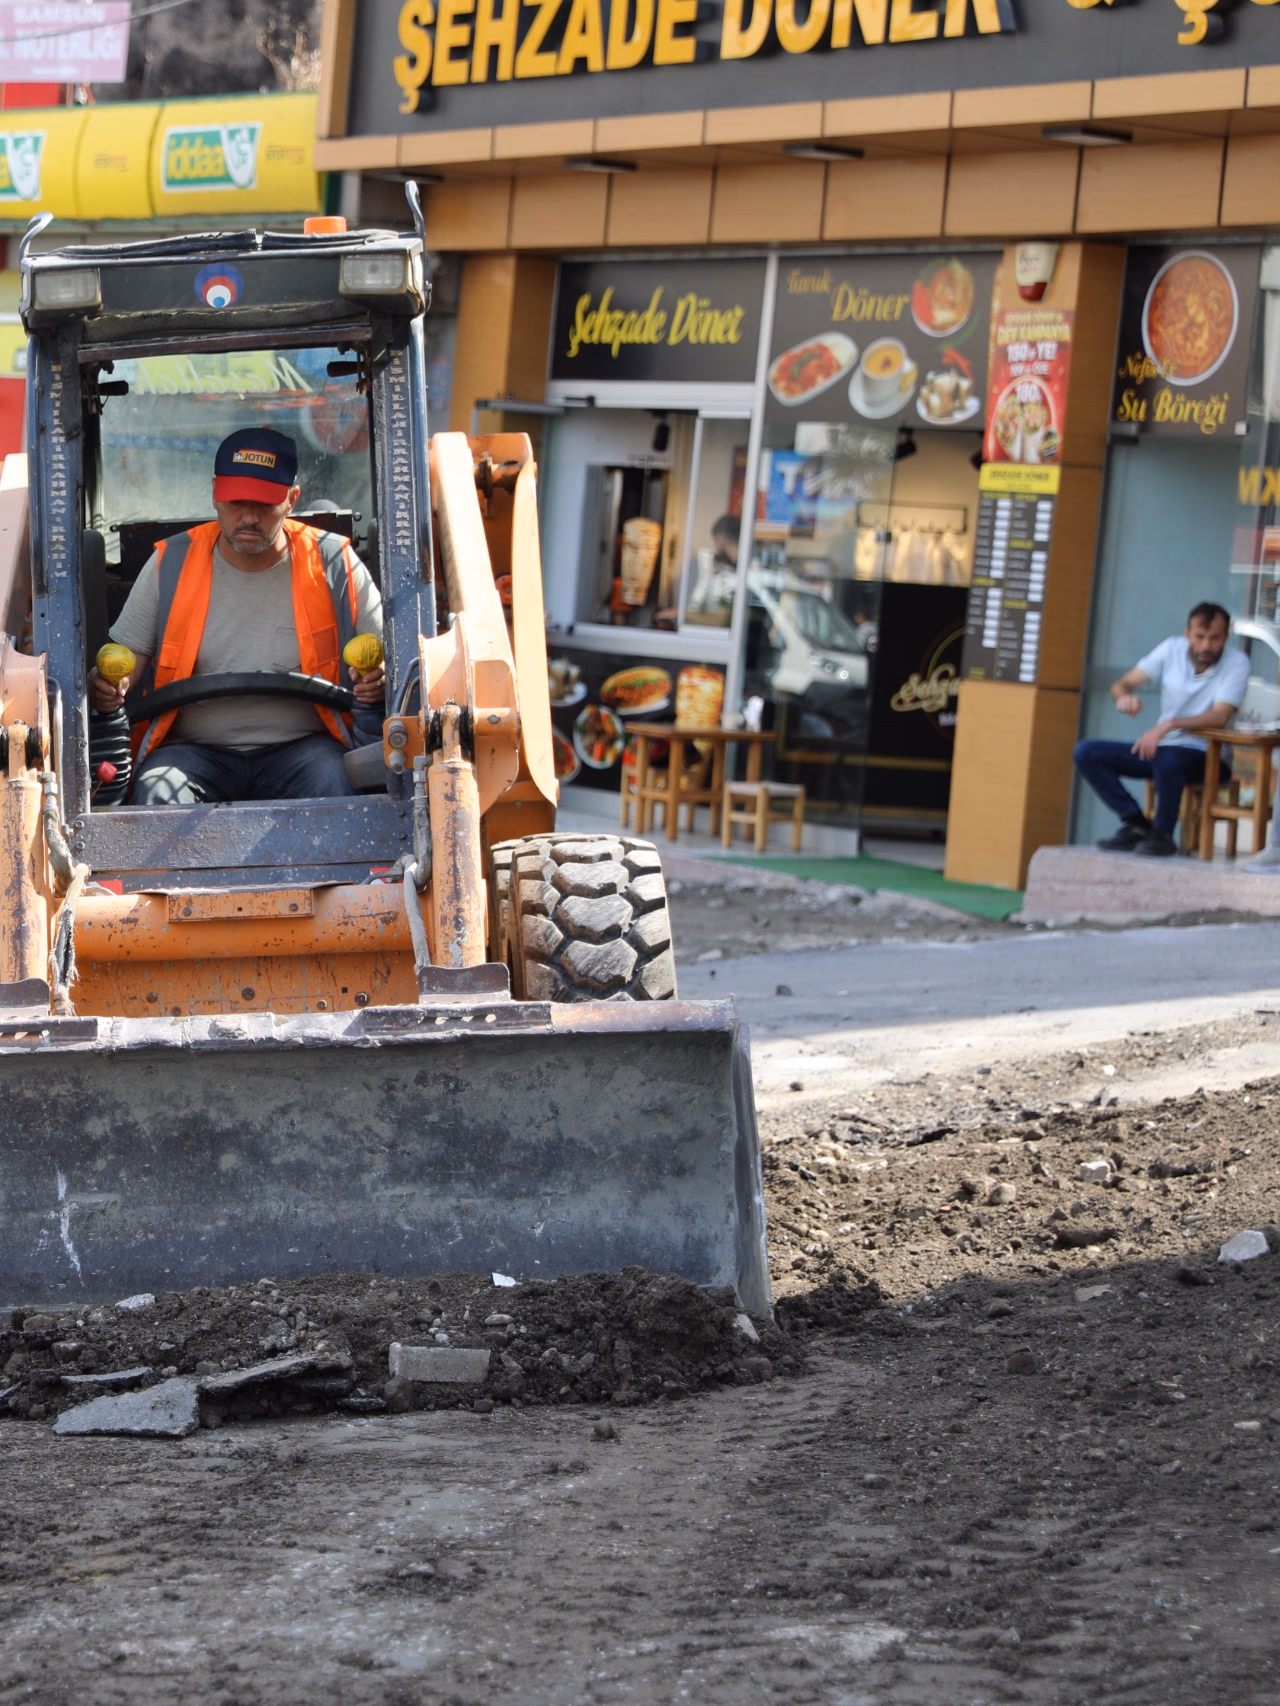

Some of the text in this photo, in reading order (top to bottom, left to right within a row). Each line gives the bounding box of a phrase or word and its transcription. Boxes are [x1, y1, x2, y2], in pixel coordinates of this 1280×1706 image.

[13, 6, 106, 23] SAMSUN
[667, 291, 746, 347] Döner
[829, 280, 910, 322] Döner
[1117, 385, 1230, 435] Su Böreği
[243, 453, 275, 466] JOTUN
